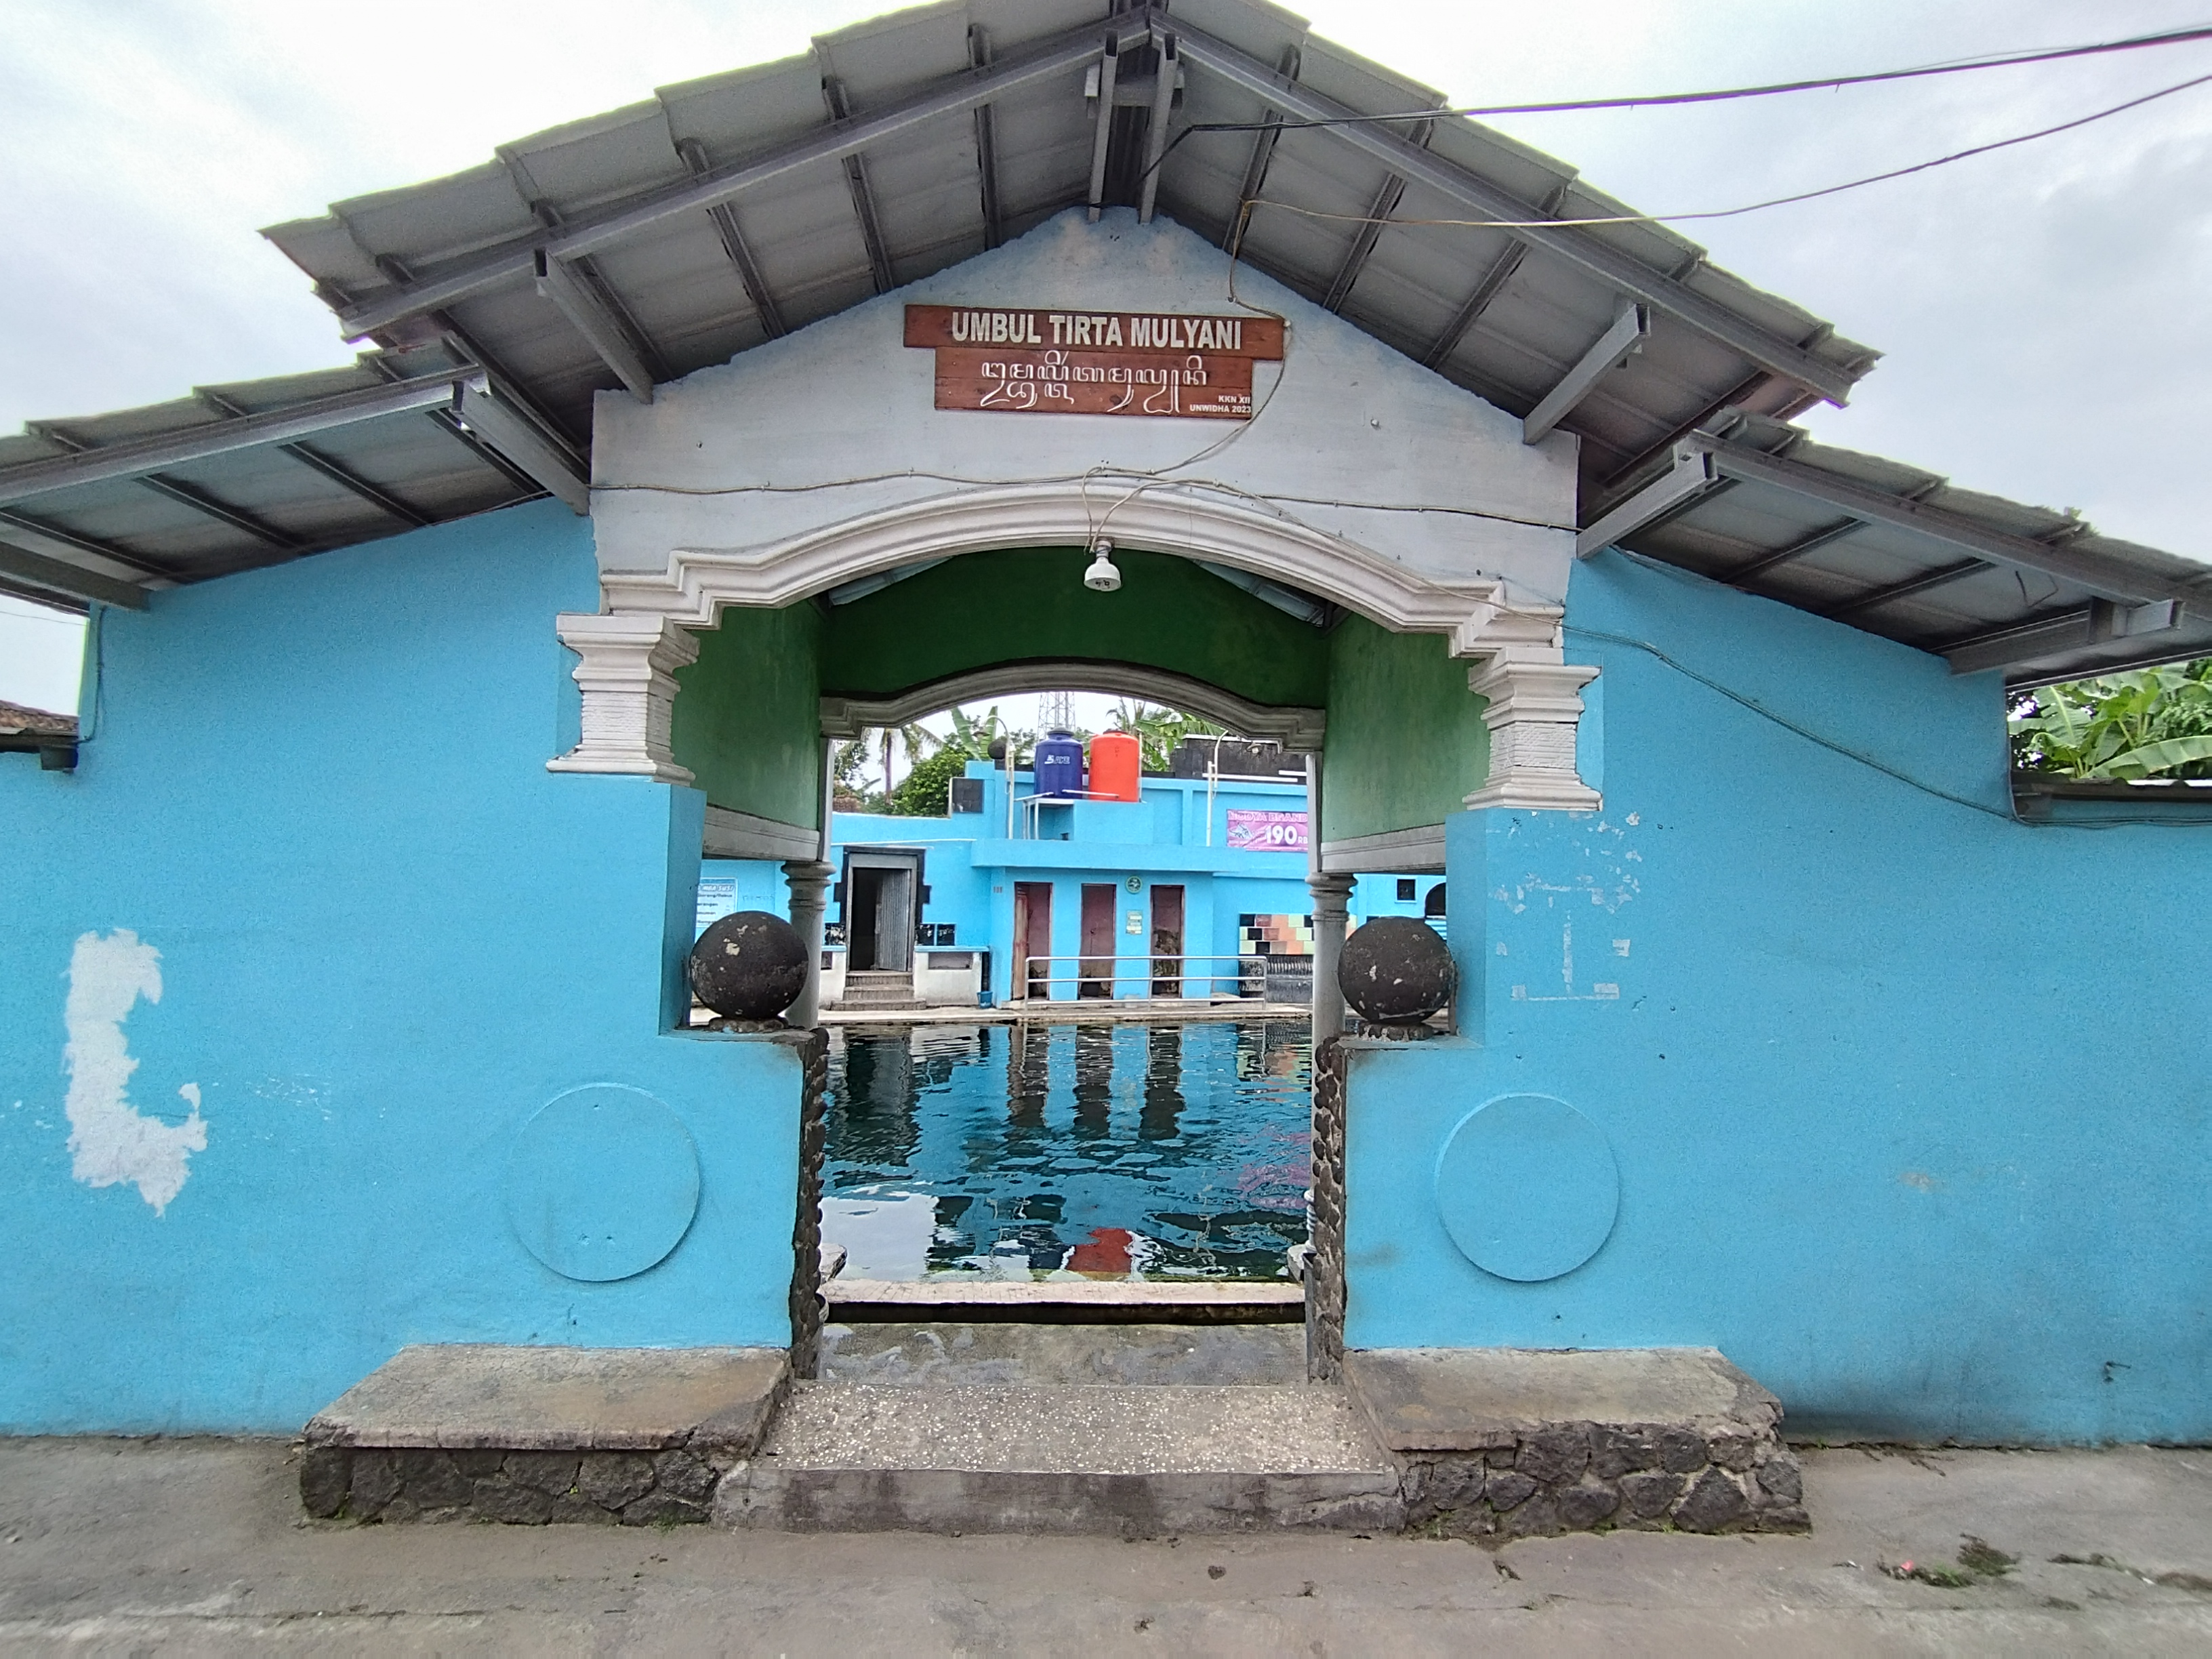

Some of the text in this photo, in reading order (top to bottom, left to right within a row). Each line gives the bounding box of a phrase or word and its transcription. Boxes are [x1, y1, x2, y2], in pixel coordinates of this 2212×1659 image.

[951, 312, 1242, 350] UMBUL TIRTA MULYANI
[1218, 395, 1251, 405] KKN XII
[1189, 404, 1252, 413] UNWIDHA 2023
[1268, 813, 1308, 823] BRAND
[1266, 825, 1297, 845] 190
[1298, 836, 1308, 844] RB
